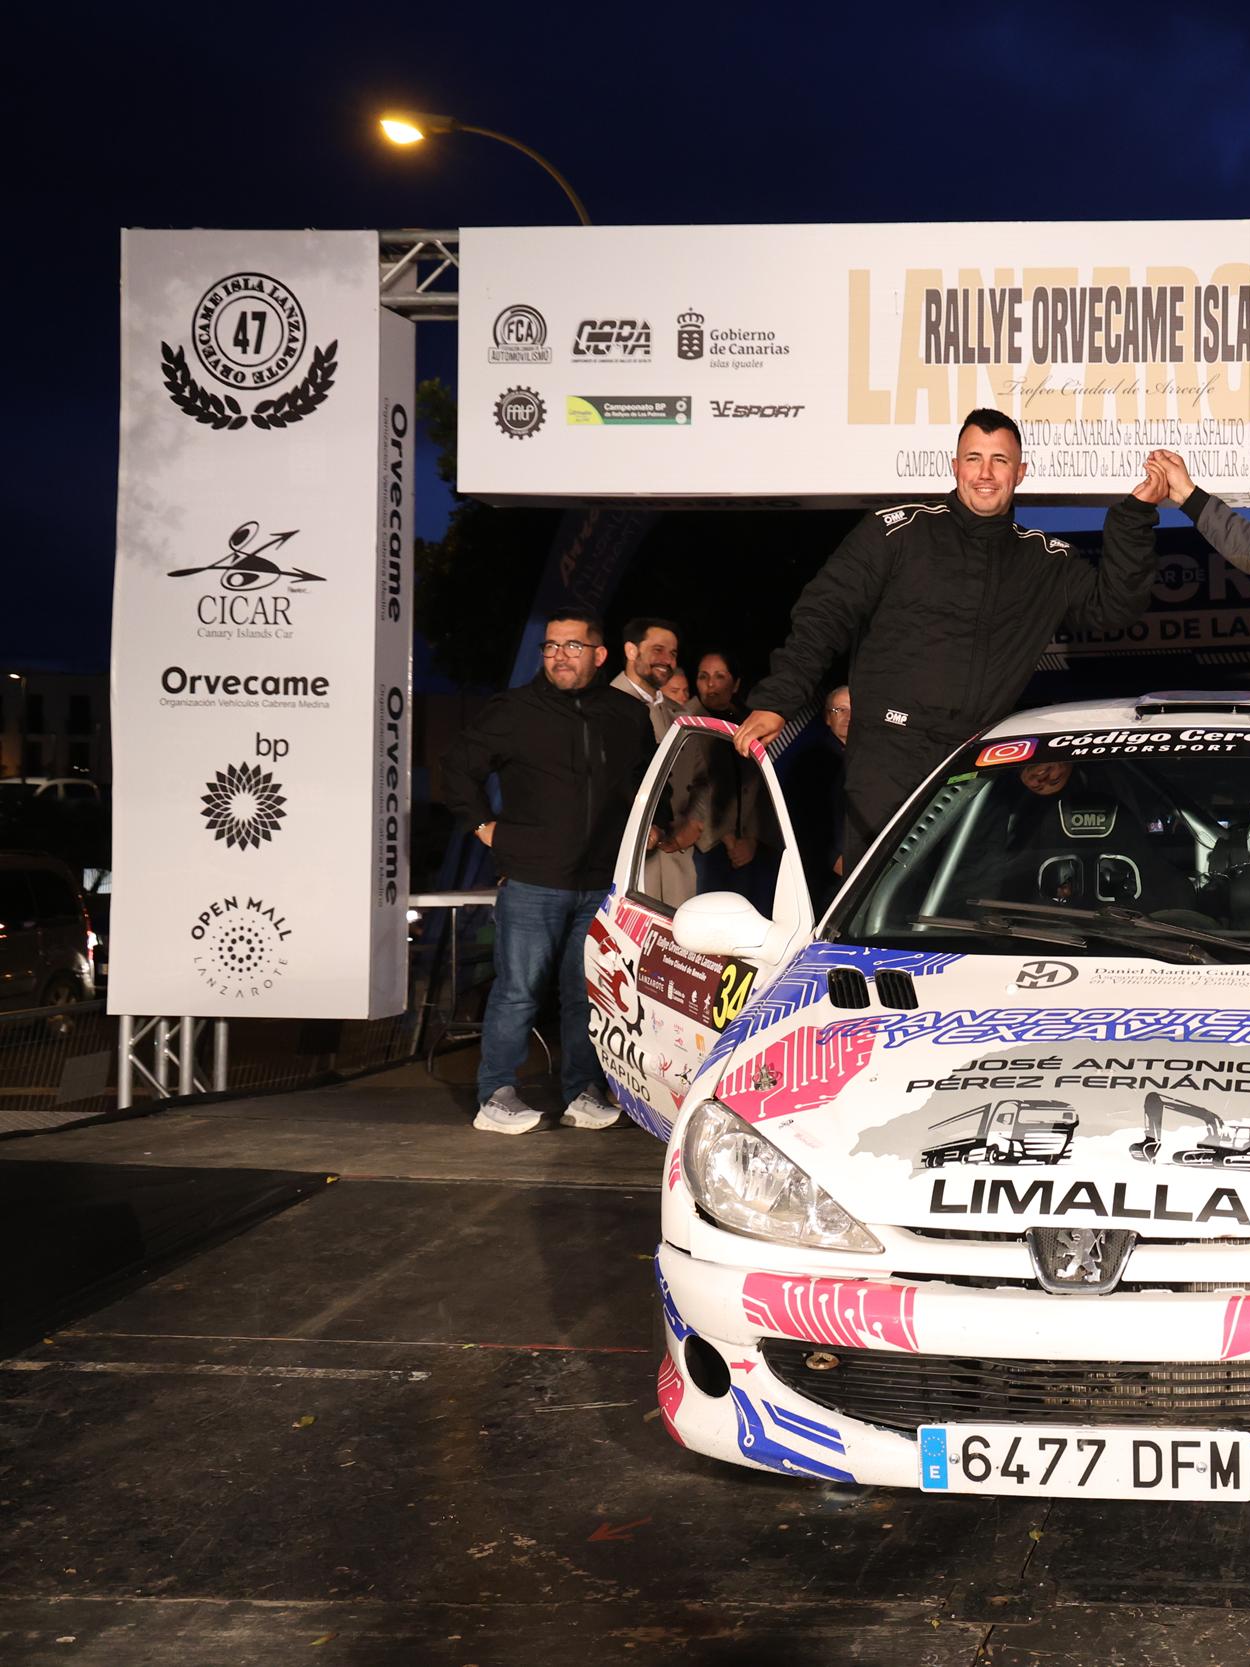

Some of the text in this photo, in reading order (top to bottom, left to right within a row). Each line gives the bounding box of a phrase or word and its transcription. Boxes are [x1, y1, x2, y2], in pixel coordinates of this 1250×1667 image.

[222, 278, 265, 296] ISLA
[233, 311, 267, 354] 47
[507, 319, 533, 342] FCA
[710, 329, 775, 342] Gobierno
[924, 287, 1023, 365] RALLYE
[1032, 285, 1184, 364] ORVECAME
[710, 344, 790, 355] de Canarias
[1061, 377, 1118, 396] Ciudad
[1122, 379, 1140, 396] de
[1064, 418, 1122, 446] CANARIAS
[1134, 418, 1182, 446] RALLYES
[1049, 450, 1098, 477] ASFALTO
[1111, 450, 1132, 477] LAS
[1189, 450, 1239, 477] INSULAR
[388, 403, 407, 624] Orvecame
[884, 511, 906, 525] OMP
[197, 595, 292, 625] CICAR
[197, 628, 293, 640] Canary Islands Car
[162, 666, 330, 696] Orvecame
[885, 711, 907, 724] OMP
[256, 733, 289, 762] bp
[1048, 731, 1171, 748] Código
[1071, 744, 1237, 756] MOTORSPORT
[385, 686, 404, 906] Orvecame
[1071, 814, 1106, 827] OMP
[191, 896, 292, 941] OPEN MALL
[194, 955, 288, 998] LANZAROTE
[713, 964, 753, 1029] 34
[952, 1056, 1063, 1072] JOSÉ
[906, 1075, 1044, 1093] PÉREZ
[930, 1465, 940, 1479] E
[961, 1435, 1240, 1490] 6477 DFM
